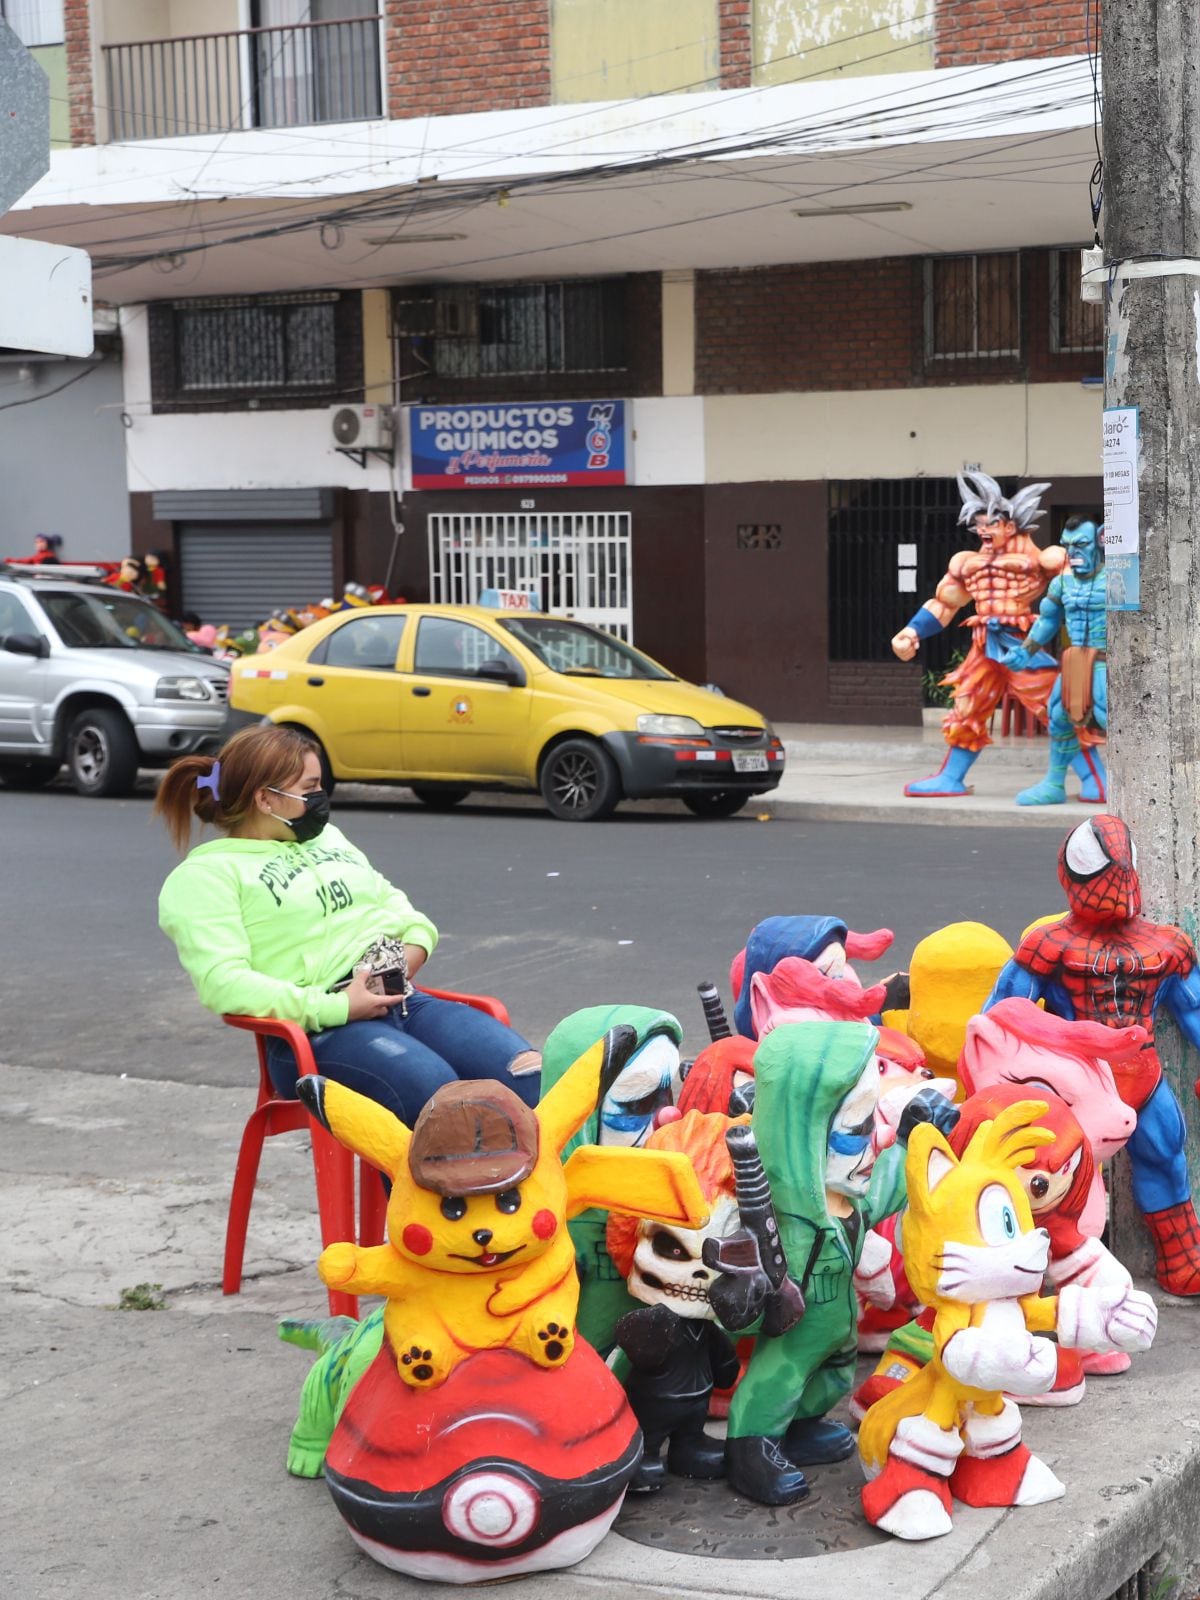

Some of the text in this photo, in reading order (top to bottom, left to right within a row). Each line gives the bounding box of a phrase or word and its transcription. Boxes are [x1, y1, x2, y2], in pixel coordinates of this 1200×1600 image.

[420, 407, 574, 430] PRODUCTOS
[588, 404, 615, 421] M
[435, 429, 559, 451] QUÍMICOS
[587, 453, 609, 469] B
[501, 592, 529, 609] TAXI
